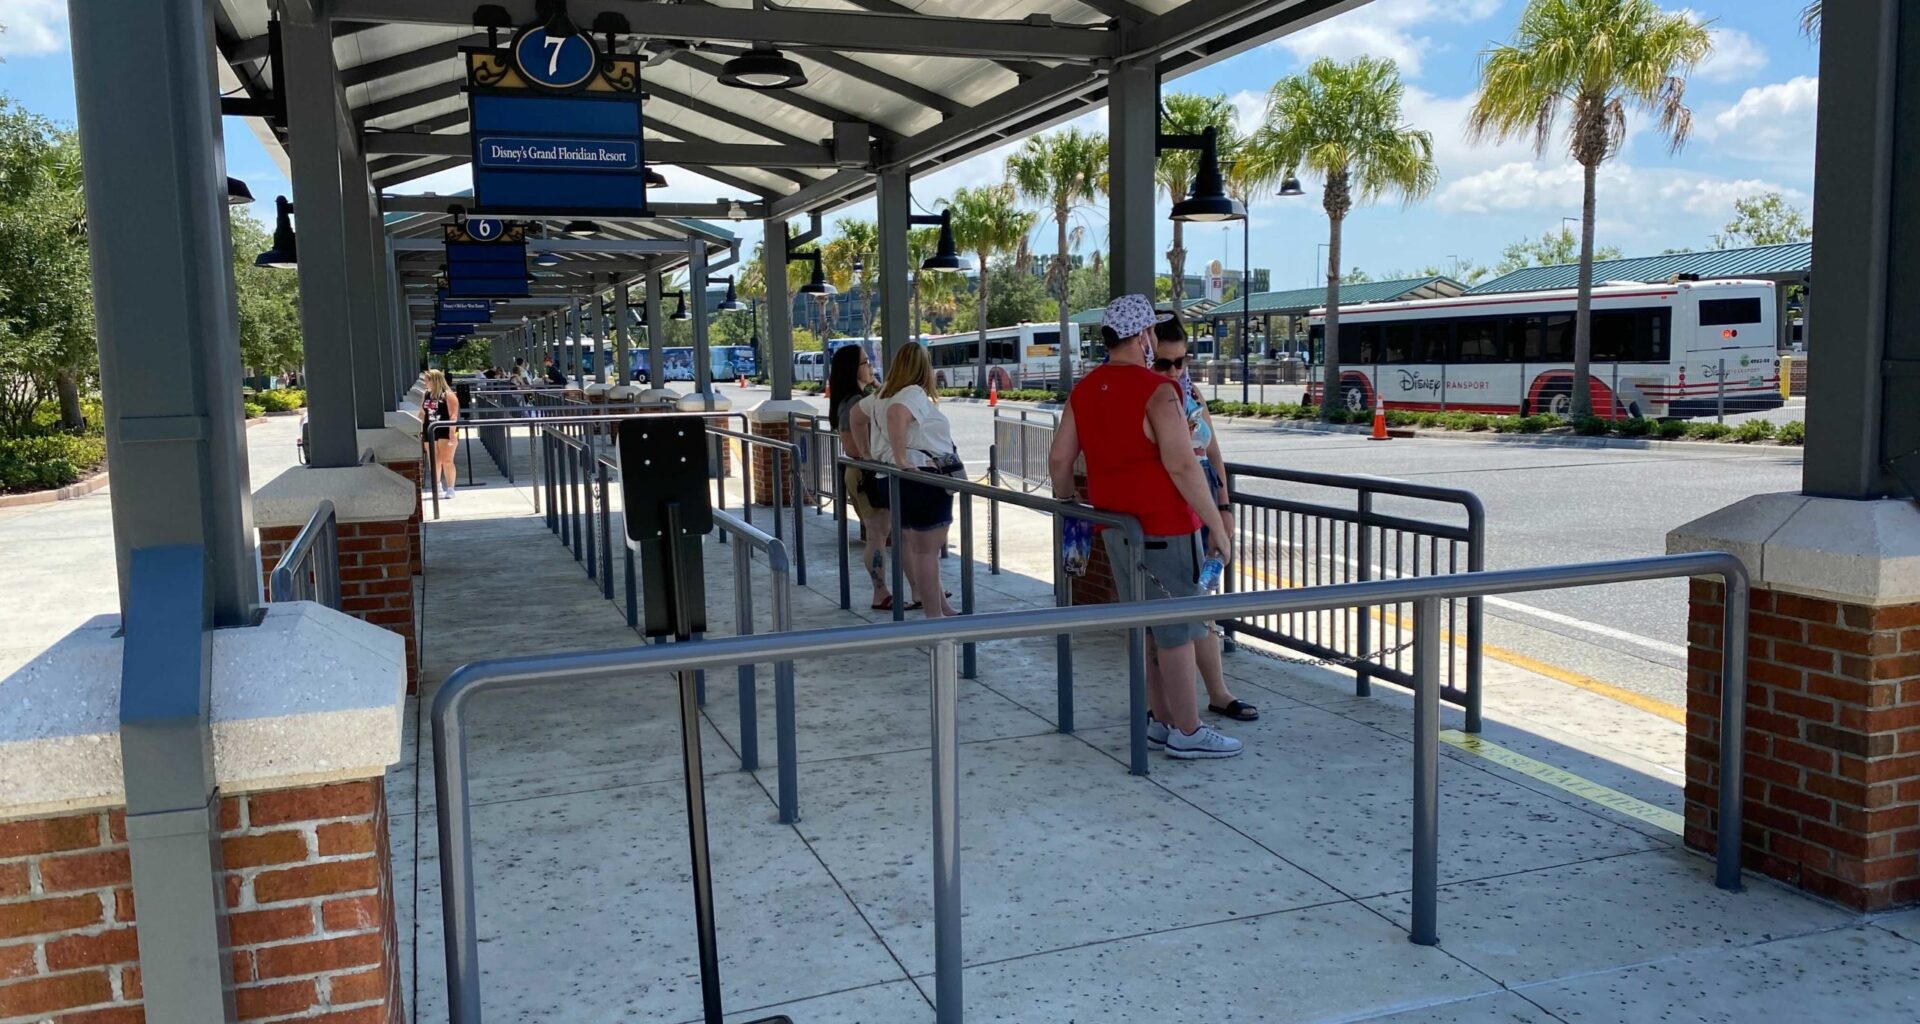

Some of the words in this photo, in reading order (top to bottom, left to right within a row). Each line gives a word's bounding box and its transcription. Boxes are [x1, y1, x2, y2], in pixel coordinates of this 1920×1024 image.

[543, 36, 567, 76] 7
[491, 145, 527, 162] Disney's
[528, 146, 557, 159] Grand
[558, 147, 597, 161] Floridian
[599, 149, 626, 162] Resort
[479, 219, 490, 236] 6
[1397, 369, 1441, 397] Disney
[1442, 380, 1489, 389] RANSPORT
[1463, 739, 1533, 770] PLEASE
[1535, 767, 1600, 794] WAIT
[1597, 791, 1671, 821] HERE
